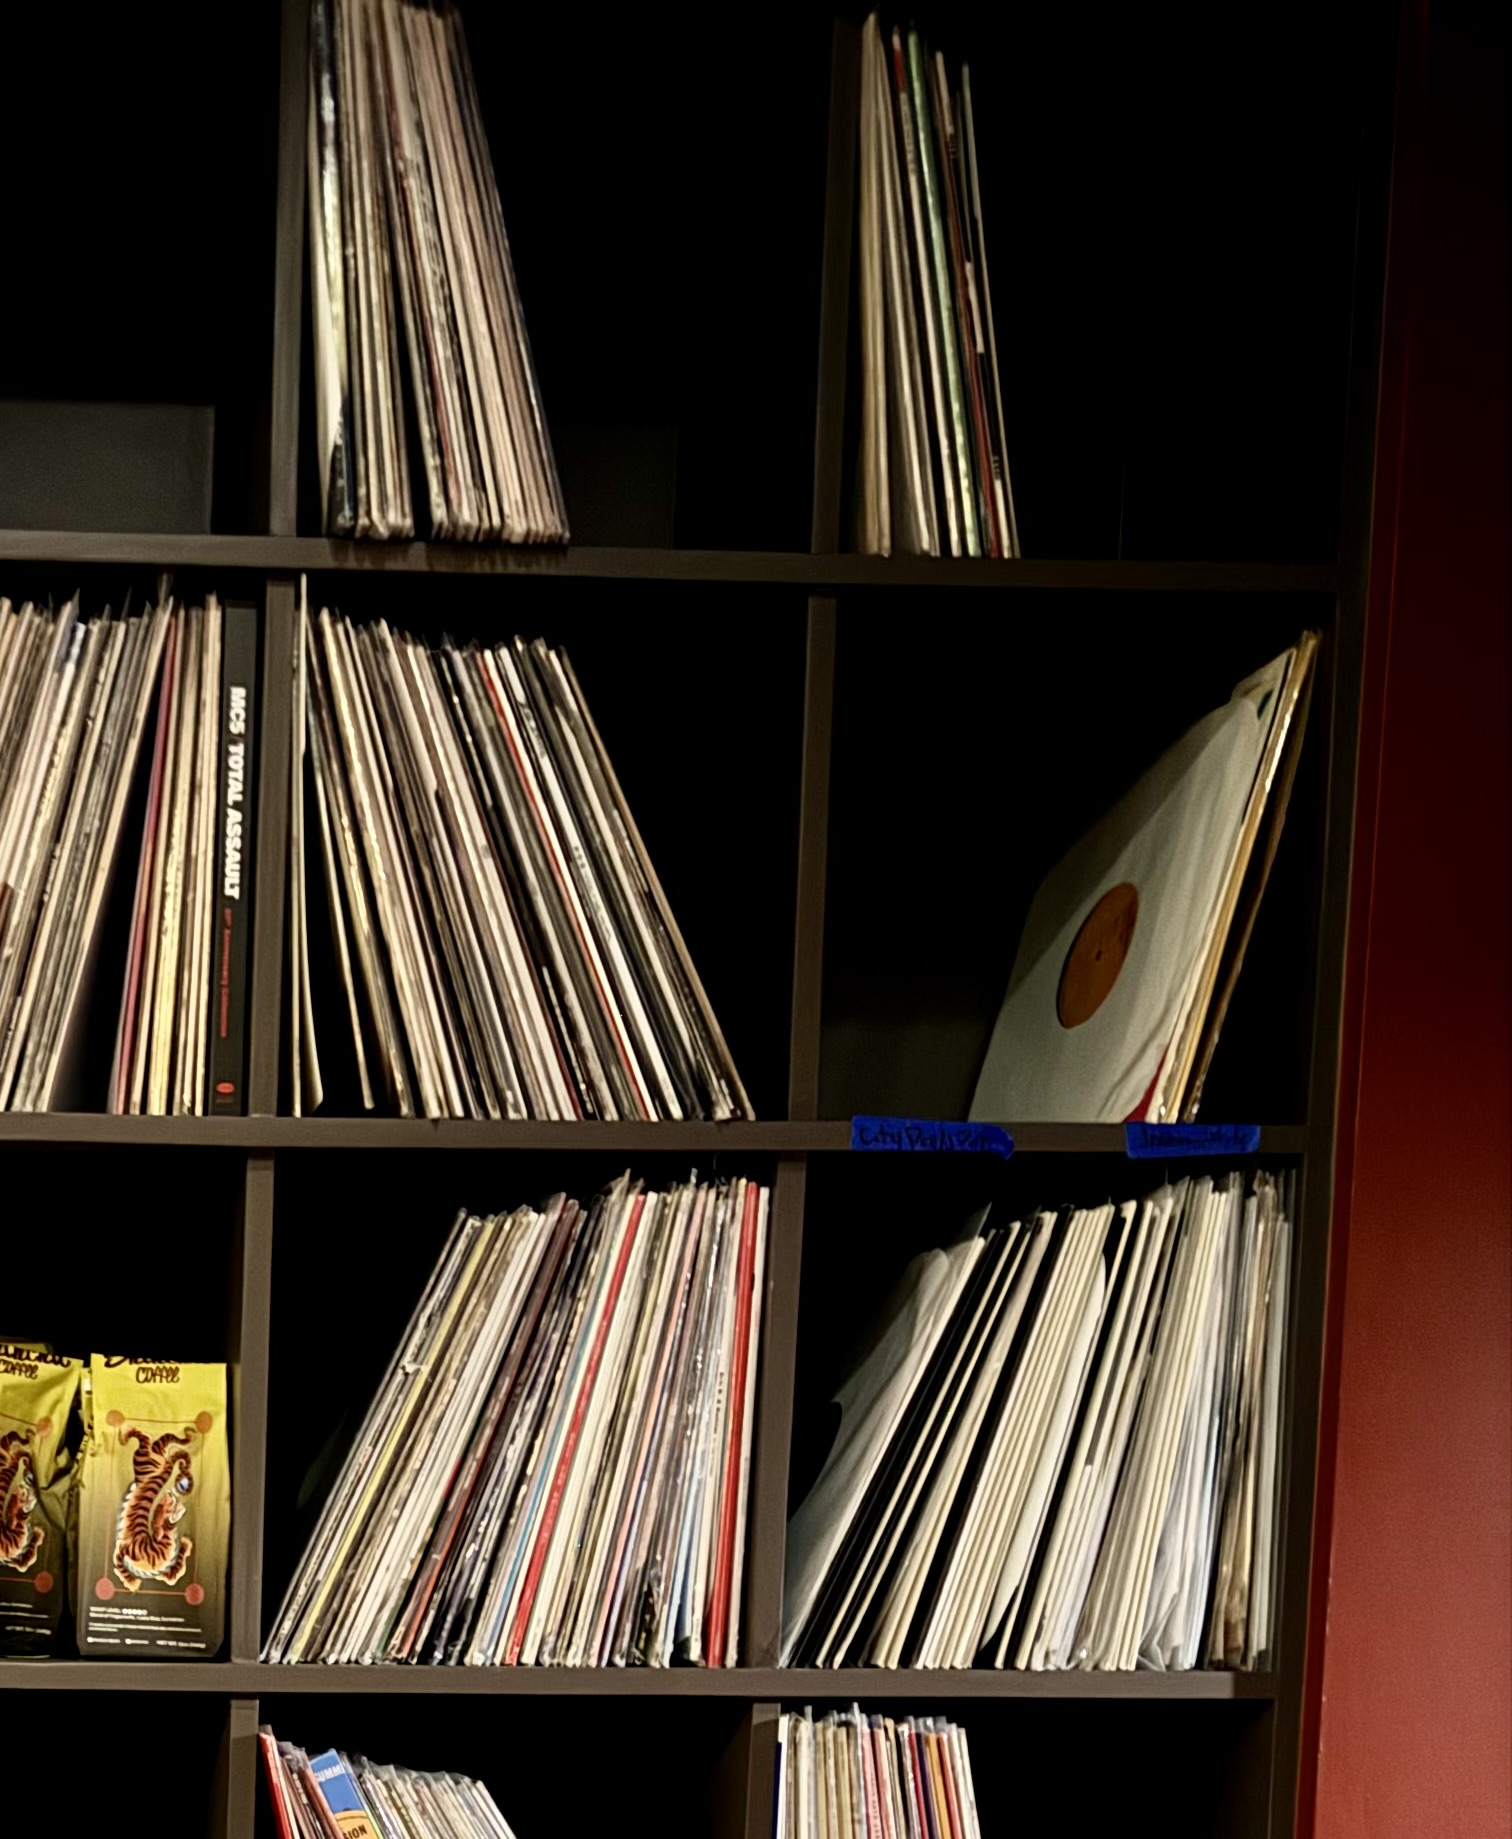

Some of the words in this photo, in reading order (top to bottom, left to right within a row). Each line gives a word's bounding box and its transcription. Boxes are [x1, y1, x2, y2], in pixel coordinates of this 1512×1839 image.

[229, 687, 246, 733] MC5
[225, 742, 244, 805] TOTAL
[222, 807, 243, 899] ASSAULT
